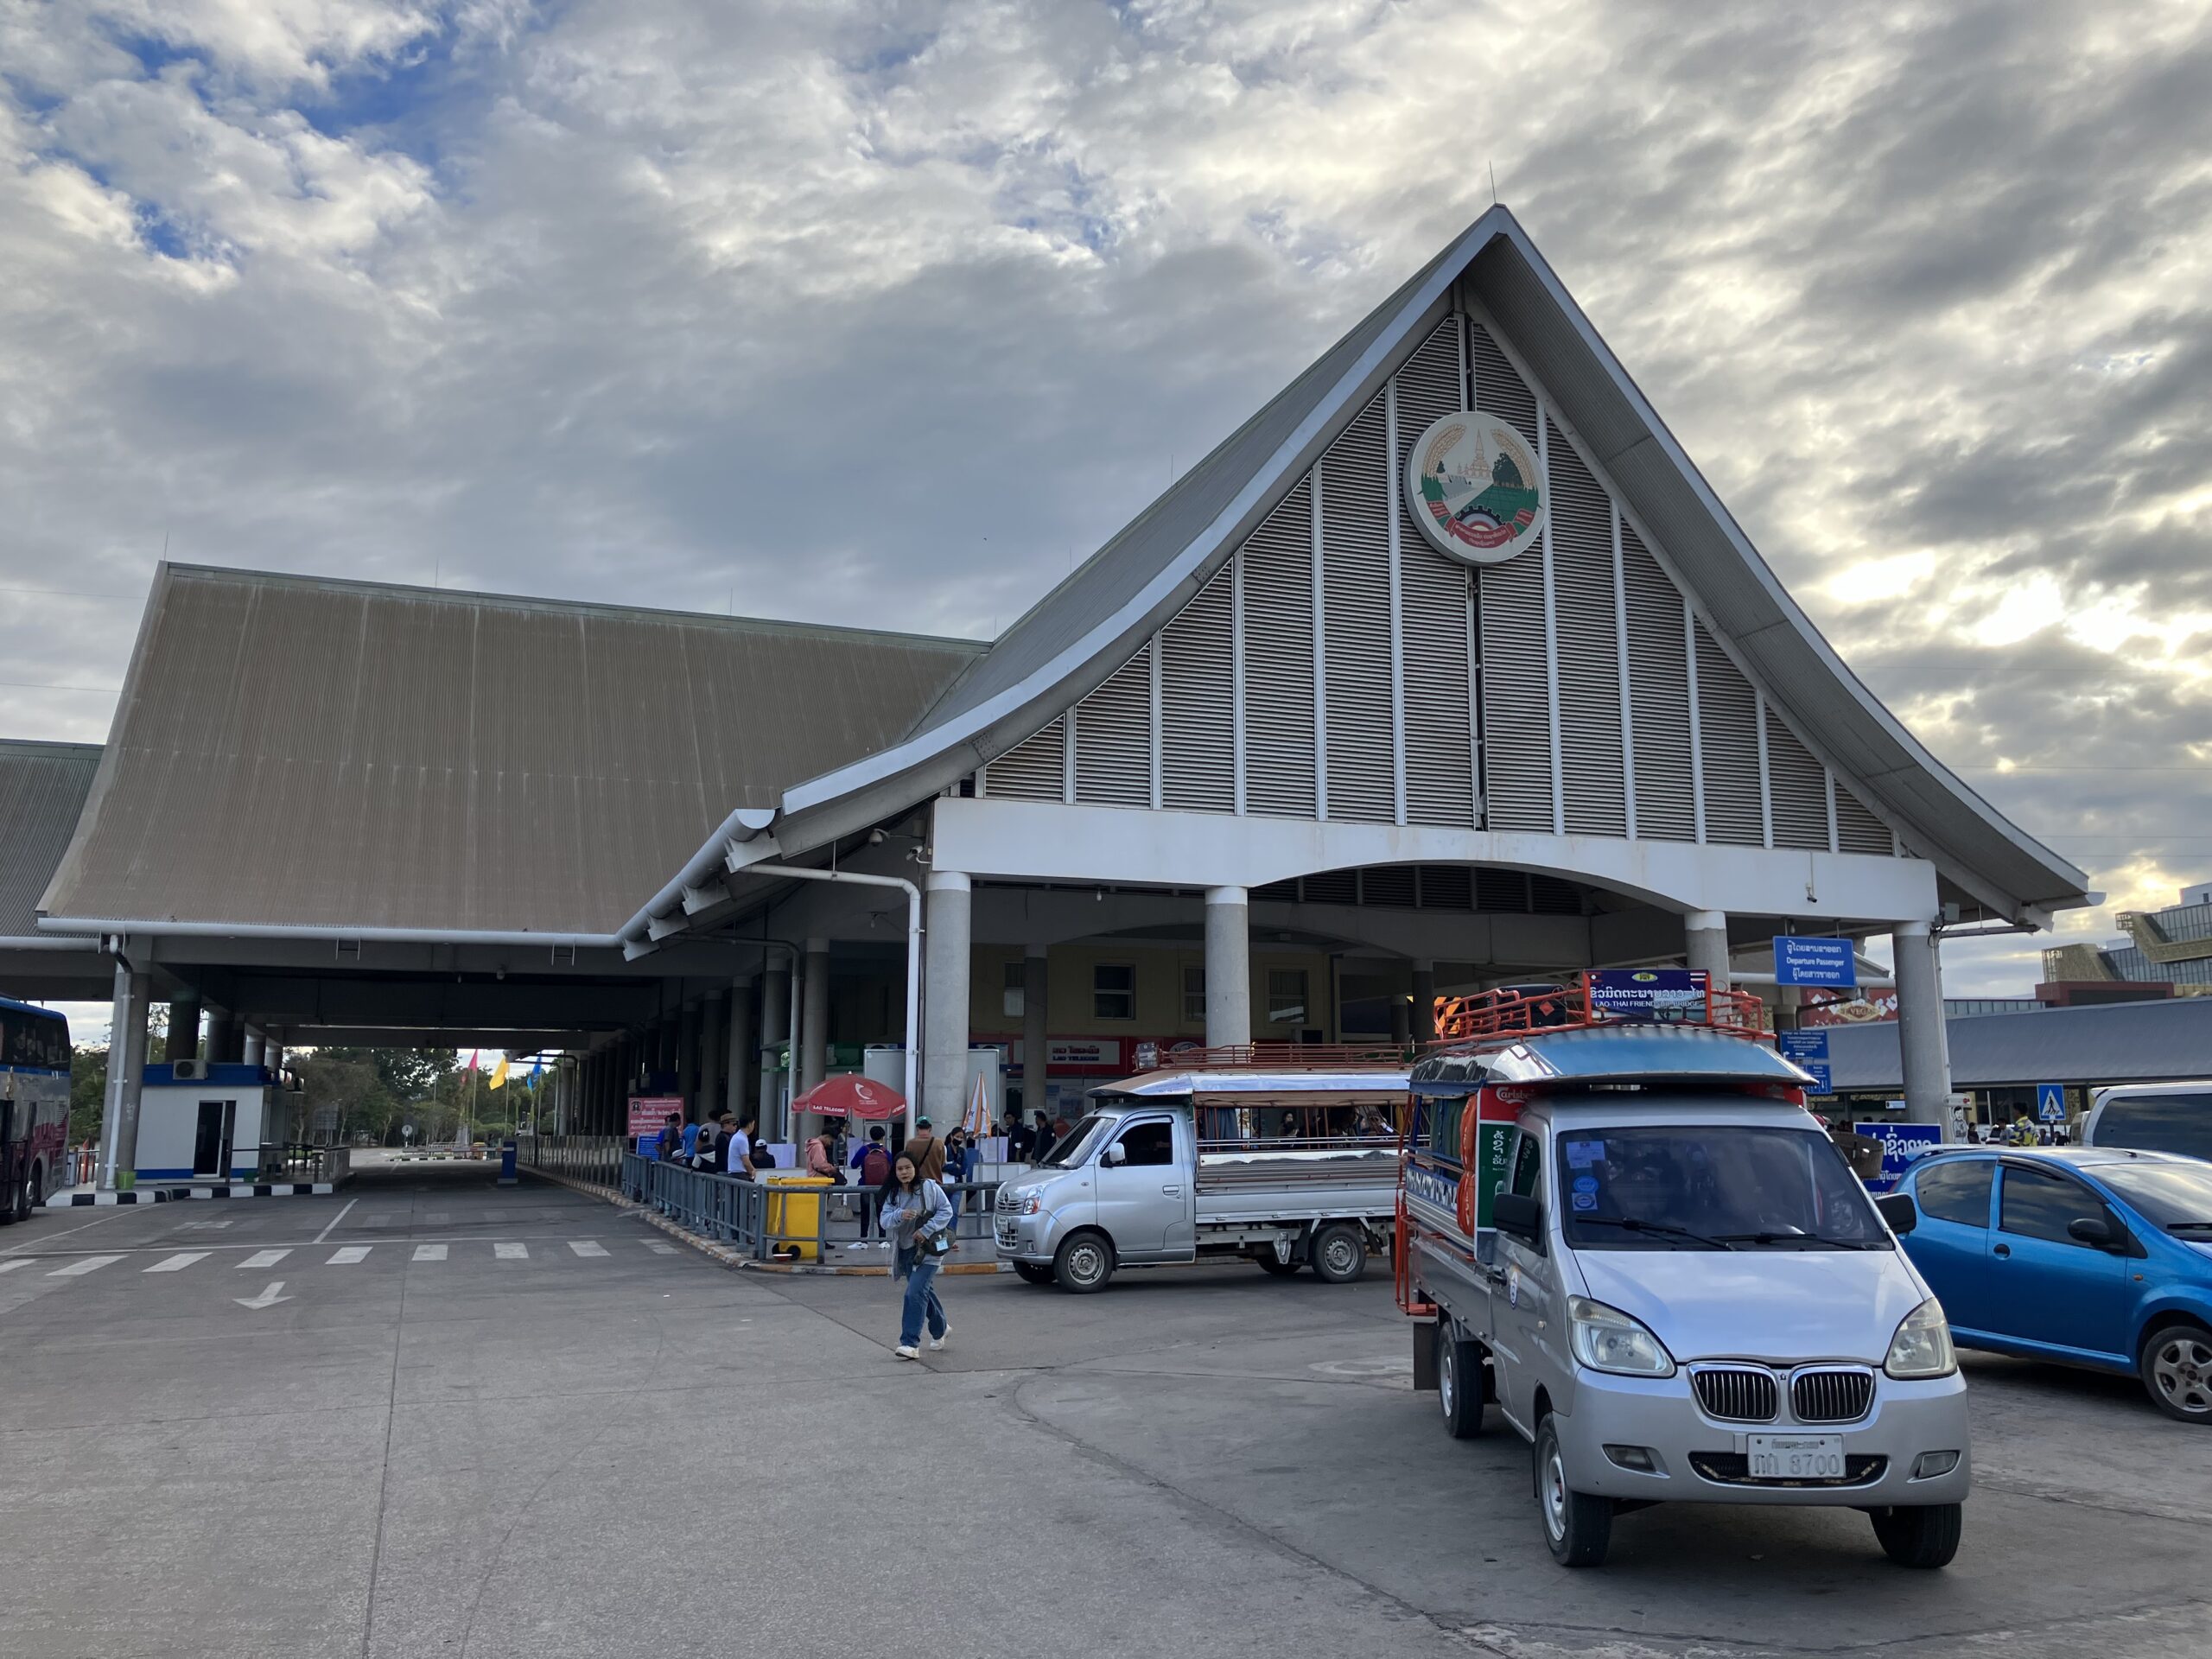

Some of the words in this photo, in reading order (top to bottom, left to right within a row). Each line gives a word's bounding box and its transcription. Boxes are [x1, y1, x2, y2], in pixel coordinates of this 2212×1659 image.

[1786, 957, 1815, 966] Departure
[1815, 957, 1845, 967] Passenger
[1789, 1453, 1840, 1475] 8700
